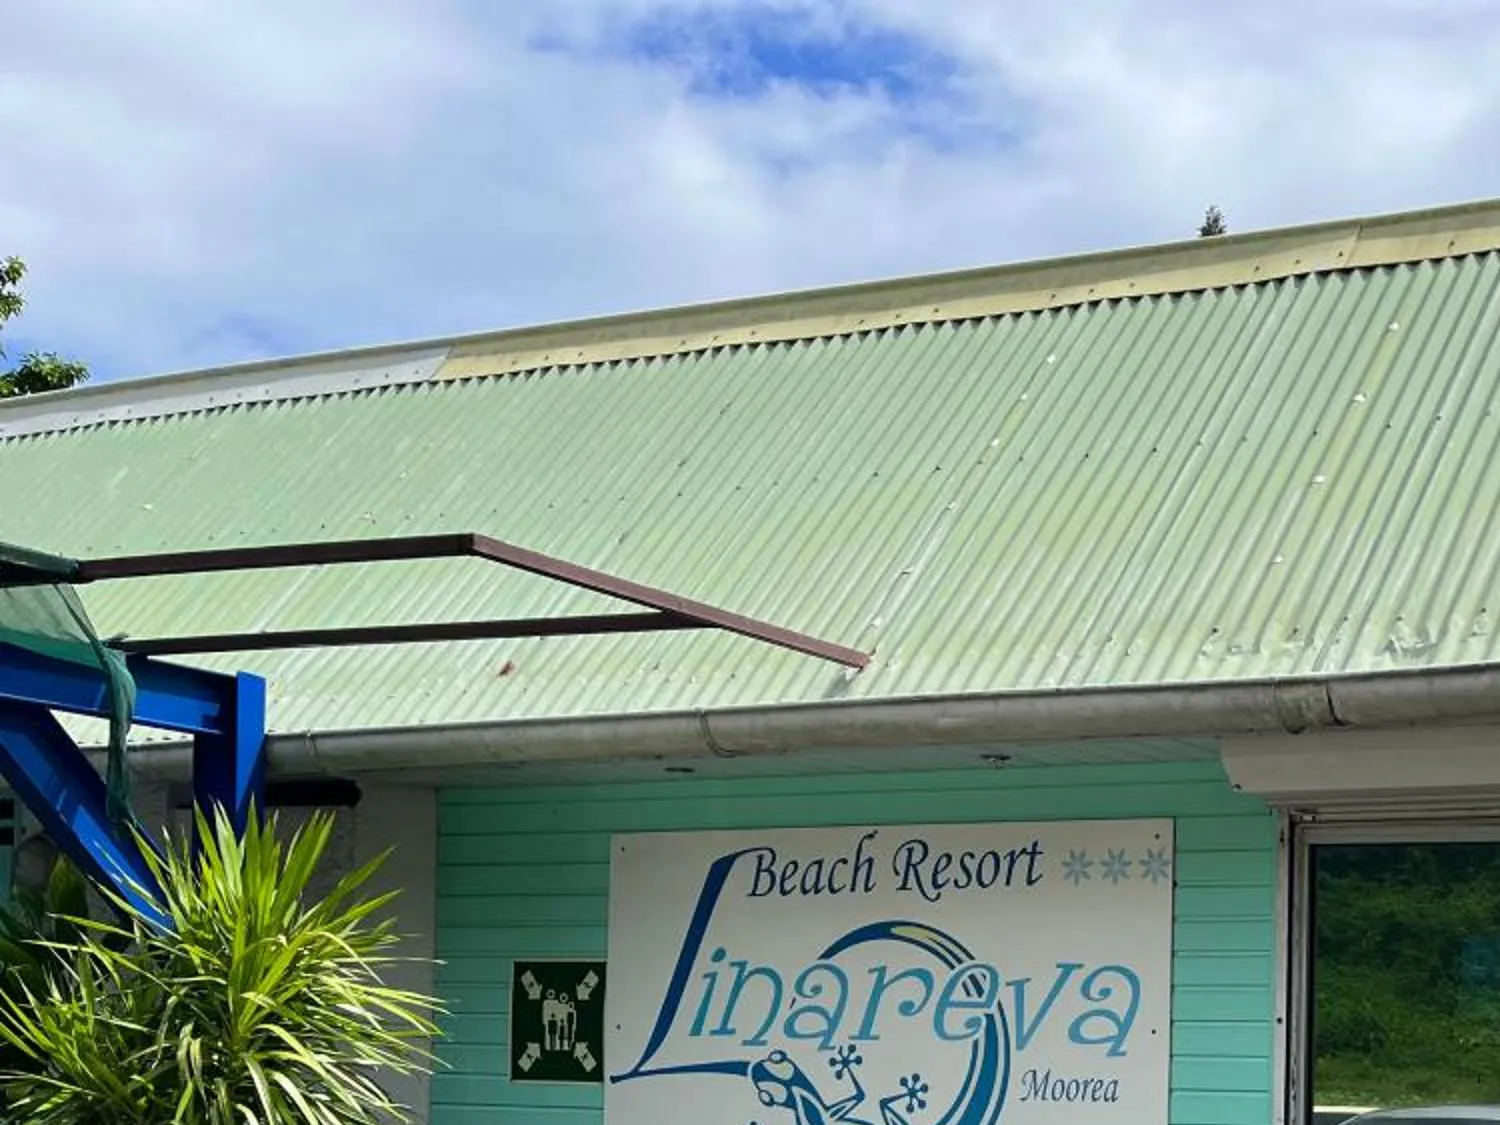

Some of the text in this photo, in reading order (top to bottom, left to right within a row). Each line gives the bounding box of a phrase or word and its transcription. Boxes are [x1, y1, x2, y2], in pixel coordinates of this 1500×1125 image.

[747, 829, 1044, 902] Beach Resort
[610, 846, 1142, 1085] Linareva
[1018, 1067, 1120, 1103] Moorea
